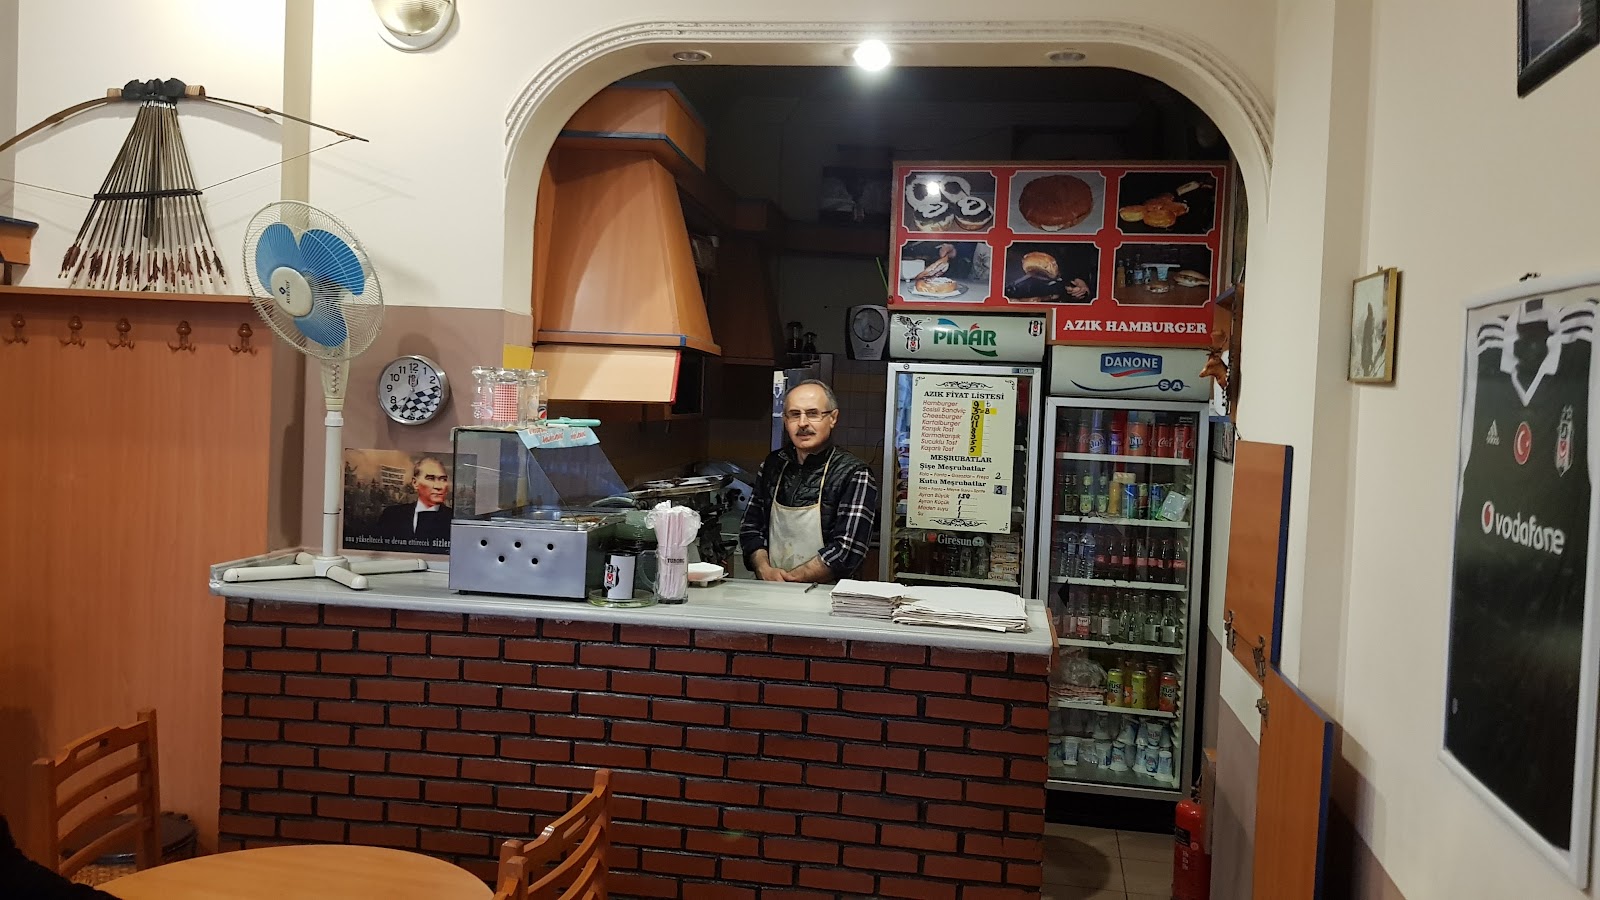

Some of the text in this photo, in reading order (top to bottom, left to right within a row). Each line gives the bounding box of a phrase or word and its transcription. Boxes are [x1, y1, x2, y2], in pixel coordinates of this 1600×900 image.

[1063, 319, 1208, 334] AZIK HAMBURGER
[1104, 355, 1159, 369] DANONE
[398, 366, 406, 374] 11
[409, 363, 419, 372] 12
[423, 367, 427, 375] 1
[389, 373, 400, 382] 10
[429, 375, 436, 384] 2
[386, 384, 393, 393] 9
[390, 395, 397, 404] 8
[971, 392, 1005, 400] LİSTESİ
[930, 454, 993, 463] MEŞRUBATLAR
[937, 463, 986, 472] Meşrubatlar
[994, 471, 1002, 480] 2
[919, 477, 987, 487] Kutu Meşrubatlar
[995, 485, 1003, 494] 3
[1495, 511, 1567, 556] vodafone
[355, 534, 384, 544] yükseltecek
[391, 536, 407, 545] devam
[408, 538, 430, 547] ettirecek
[937, 533, 973, 547] Giresun
